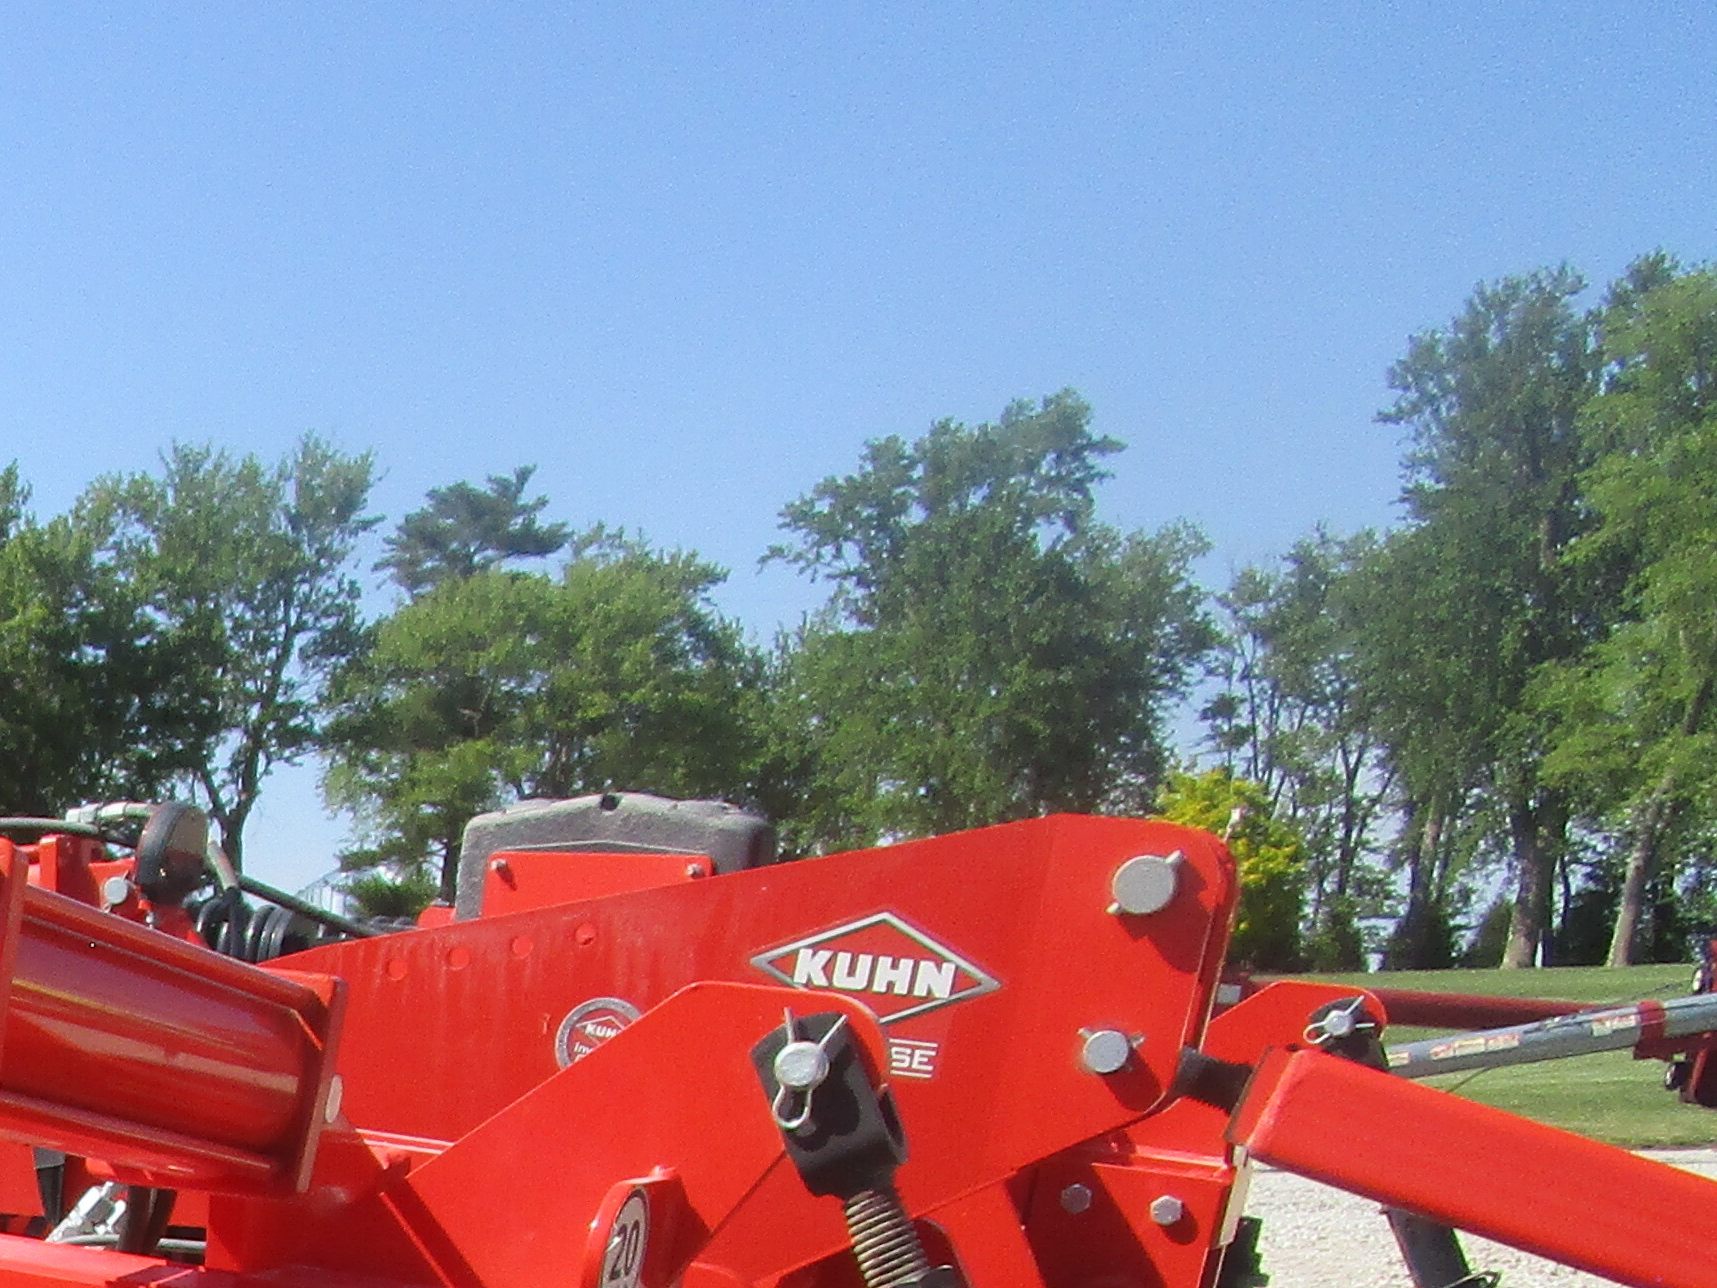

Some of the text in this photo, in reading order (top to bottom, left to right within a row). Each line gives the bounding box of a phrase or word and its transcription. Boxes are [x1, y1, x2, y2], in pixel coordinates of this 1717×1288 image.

[792, 948, 957, 999] KUHN
[585, 1022, 622, 1038] KUH
[889, 1045, 937, 1071] SE
[608, 1219, 640, 1281] 20
